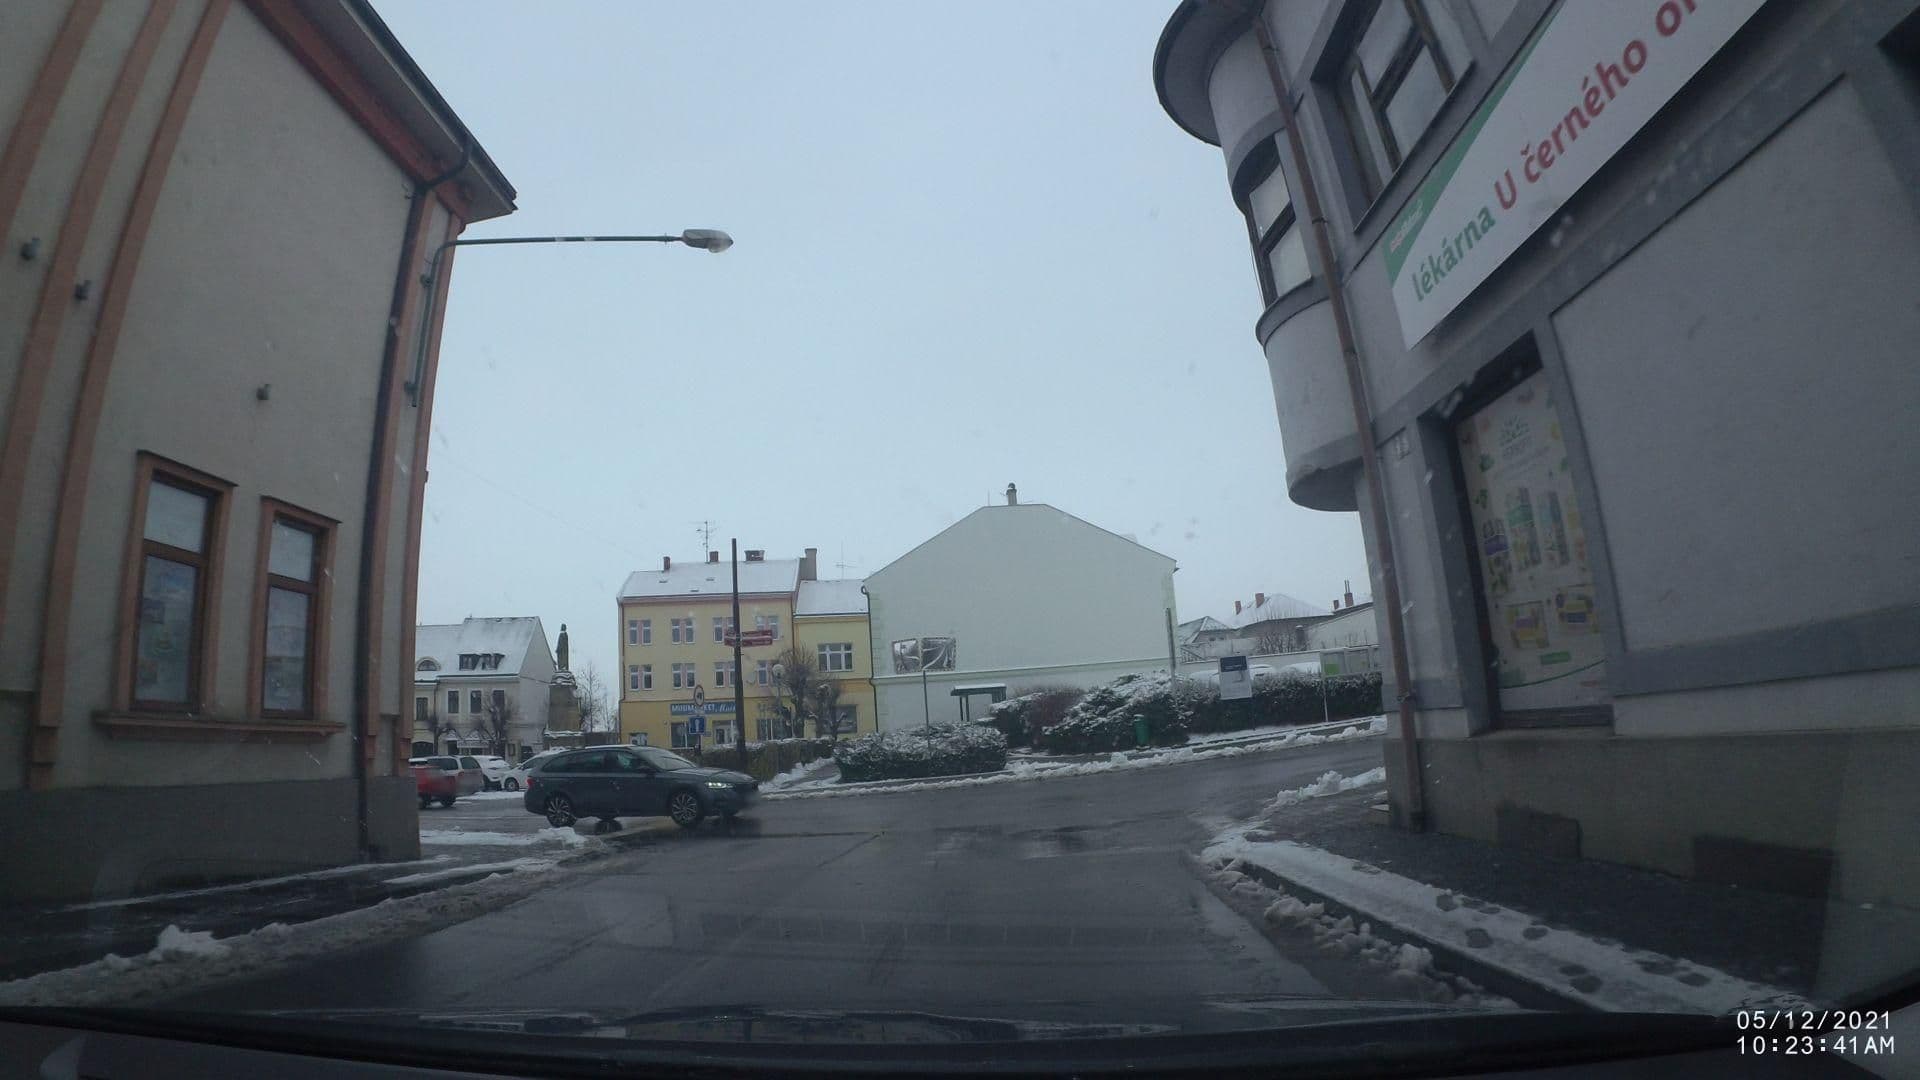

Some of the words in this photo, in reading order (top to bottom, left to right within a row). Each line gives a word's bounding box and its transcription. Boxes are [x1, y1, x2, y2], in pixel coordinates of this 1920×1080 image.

[1411, 205, 1496, 302] lékárna
[1493, 169, 1518, 211] U
[1520, 39, 1648, 185] černého
